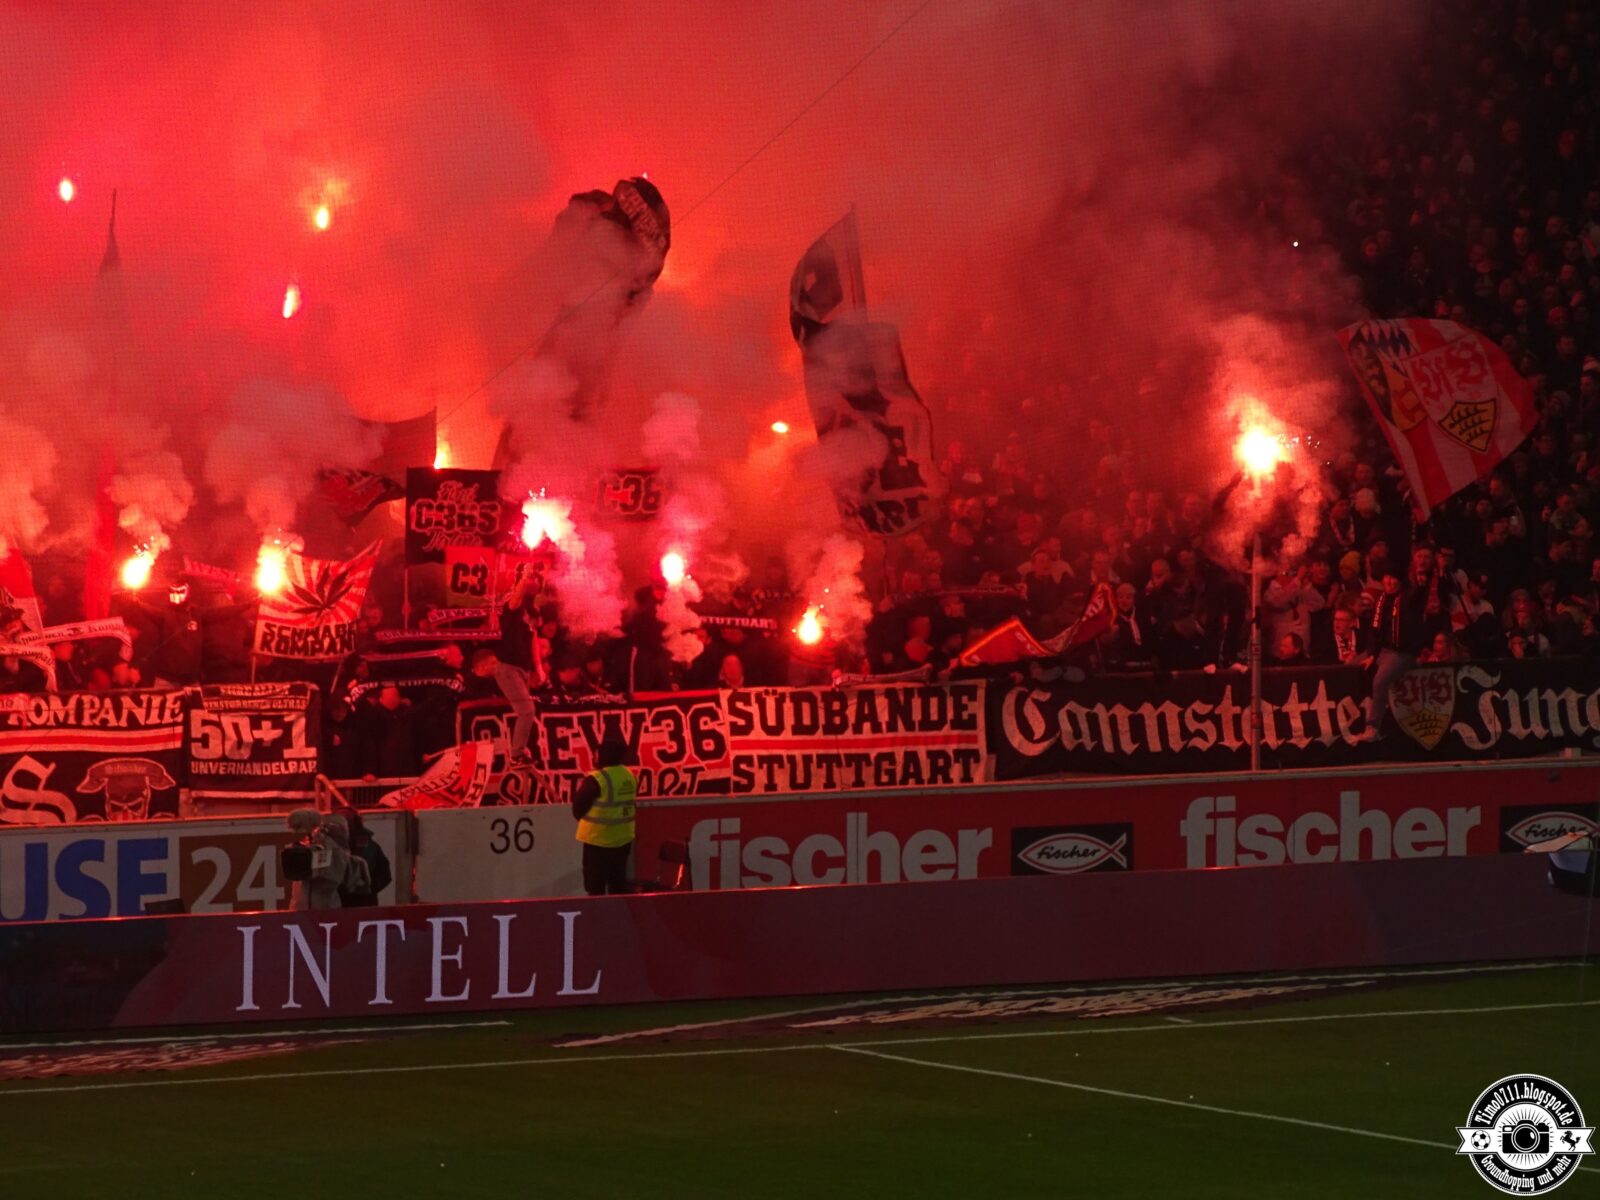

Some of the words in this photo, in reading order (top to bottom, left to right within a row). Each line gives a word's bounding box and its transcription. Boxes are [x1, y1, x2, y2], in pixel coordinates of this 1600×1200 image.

[190, 709, 317, 760] 50+1
[649, 702, 730, 766] 36
[727, 684, 977, 738] SÜDBANDE
[191, 761, 317, 776] UNVERHANDELBAR
[732, 748, 981, 793] STUTTGART
[489, 817, 535, 855] 36
[689, 812, 993, 890] fischer
[1037, 845, 1101, 860] fischer
[1180, 791, 1481, 870] fischer
[190, 845, 286, 914] 24
[235, 911, 602, 1011] INTELL
